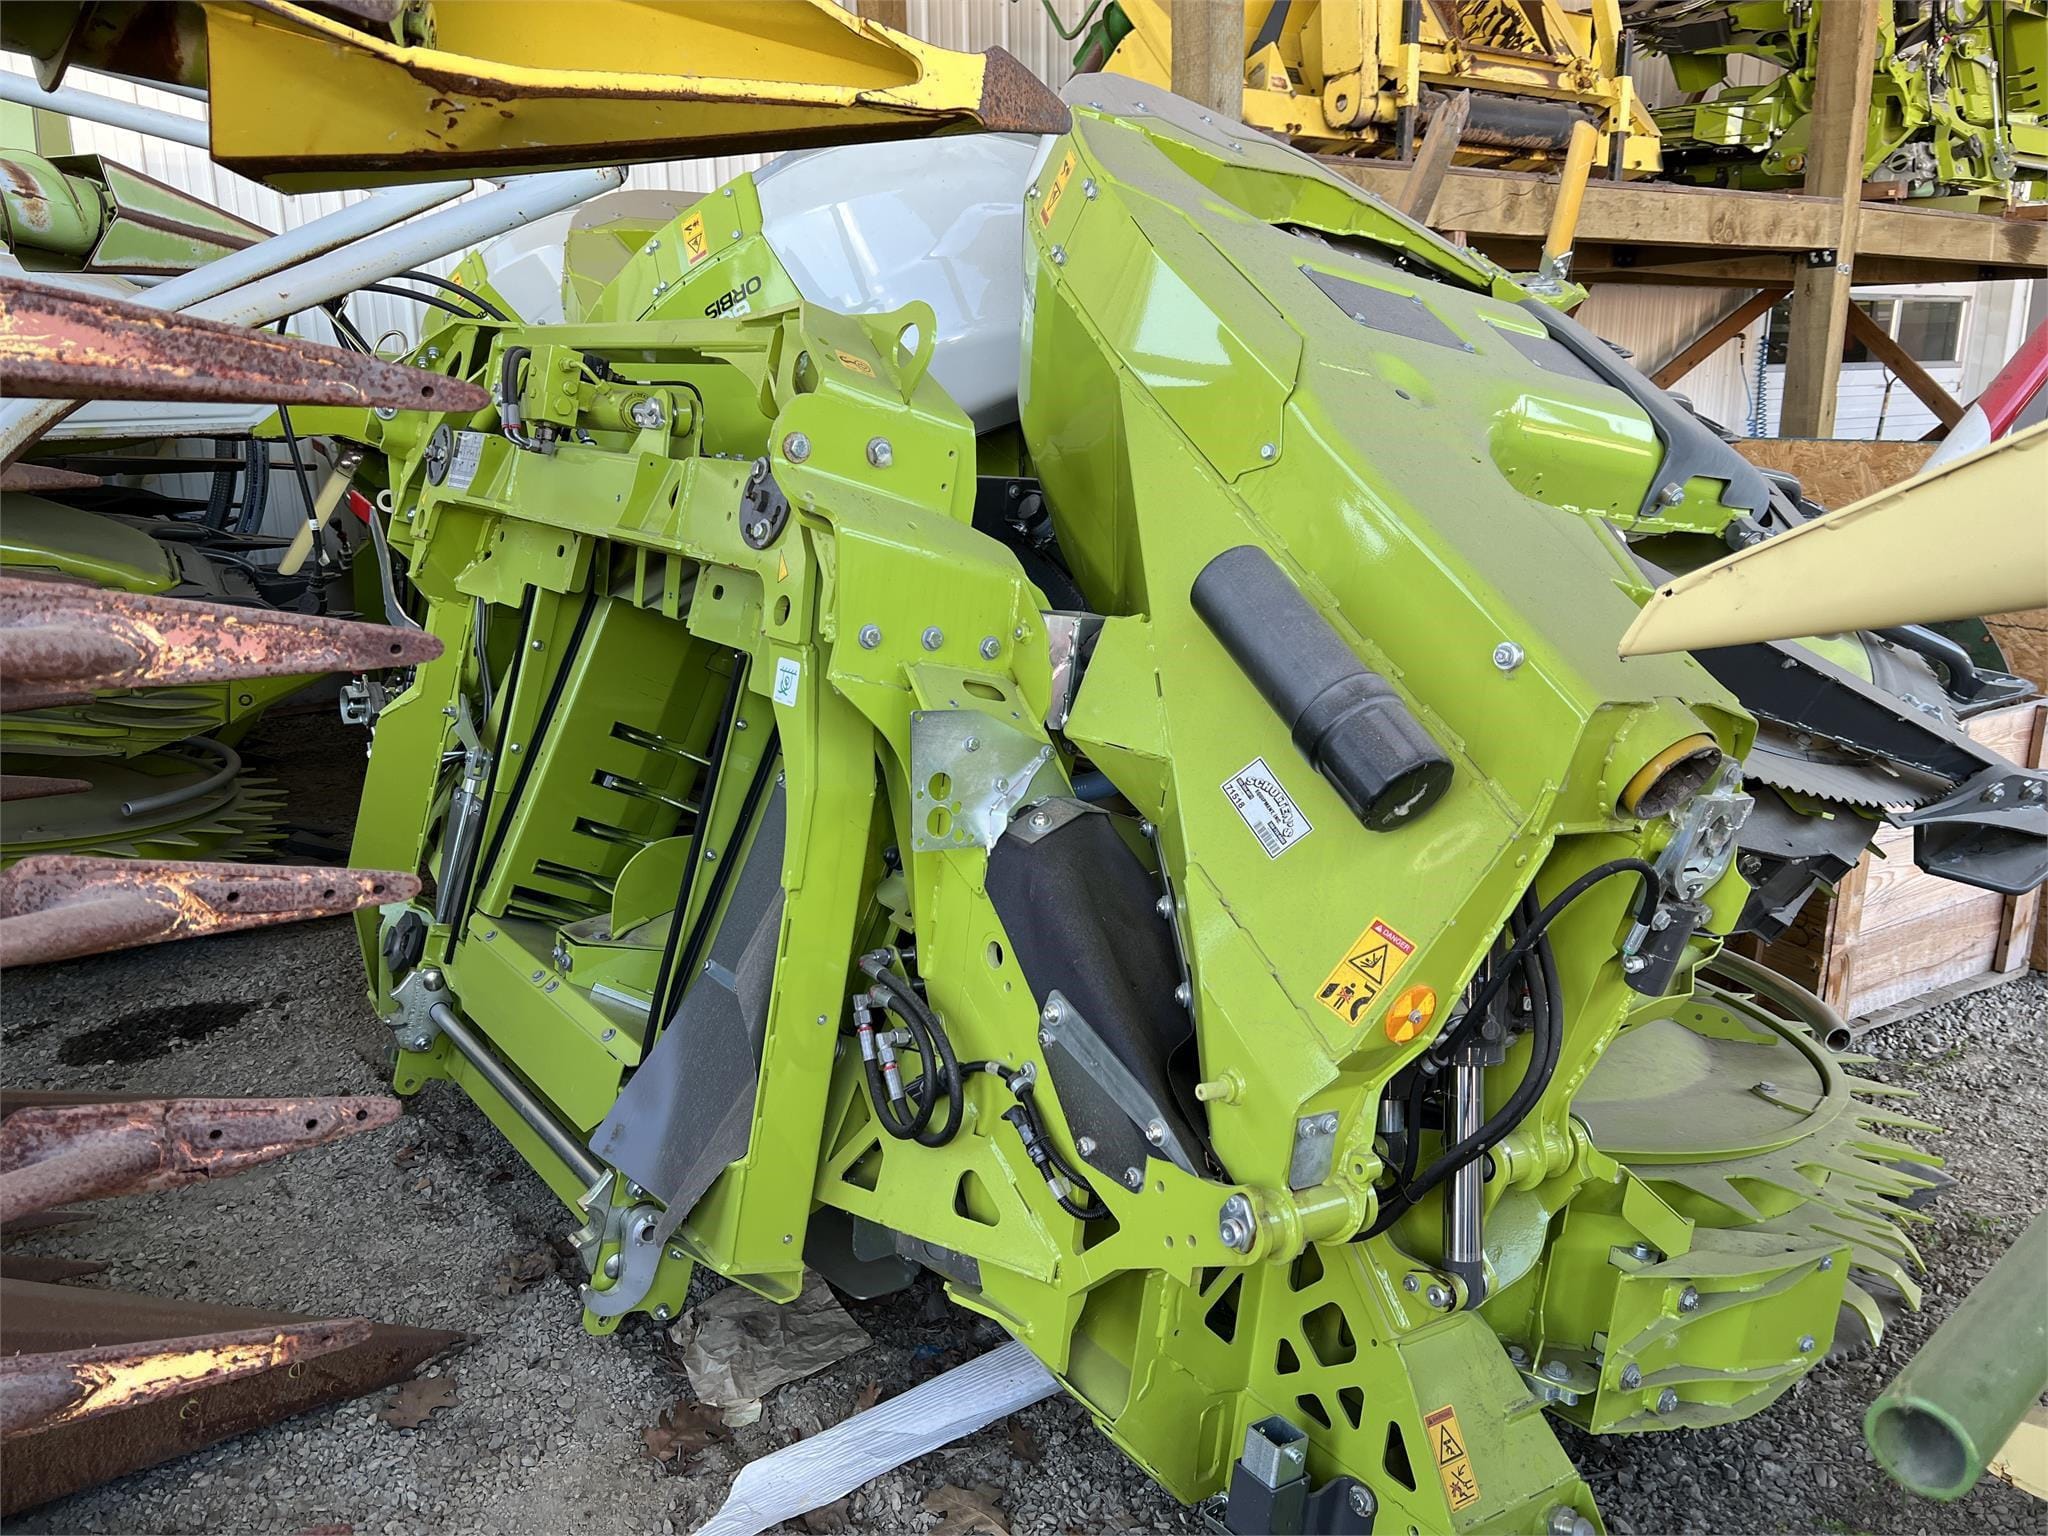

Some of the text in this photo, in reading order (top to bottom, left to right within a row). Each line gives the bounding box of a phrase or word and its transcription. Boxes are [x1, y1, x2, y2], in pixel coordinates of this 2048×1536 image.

[704, 276, 761, 318] ORBIS
[1226, 784, 1245, 808] 71518
[1382, 929, 1410, 950] DANGER
